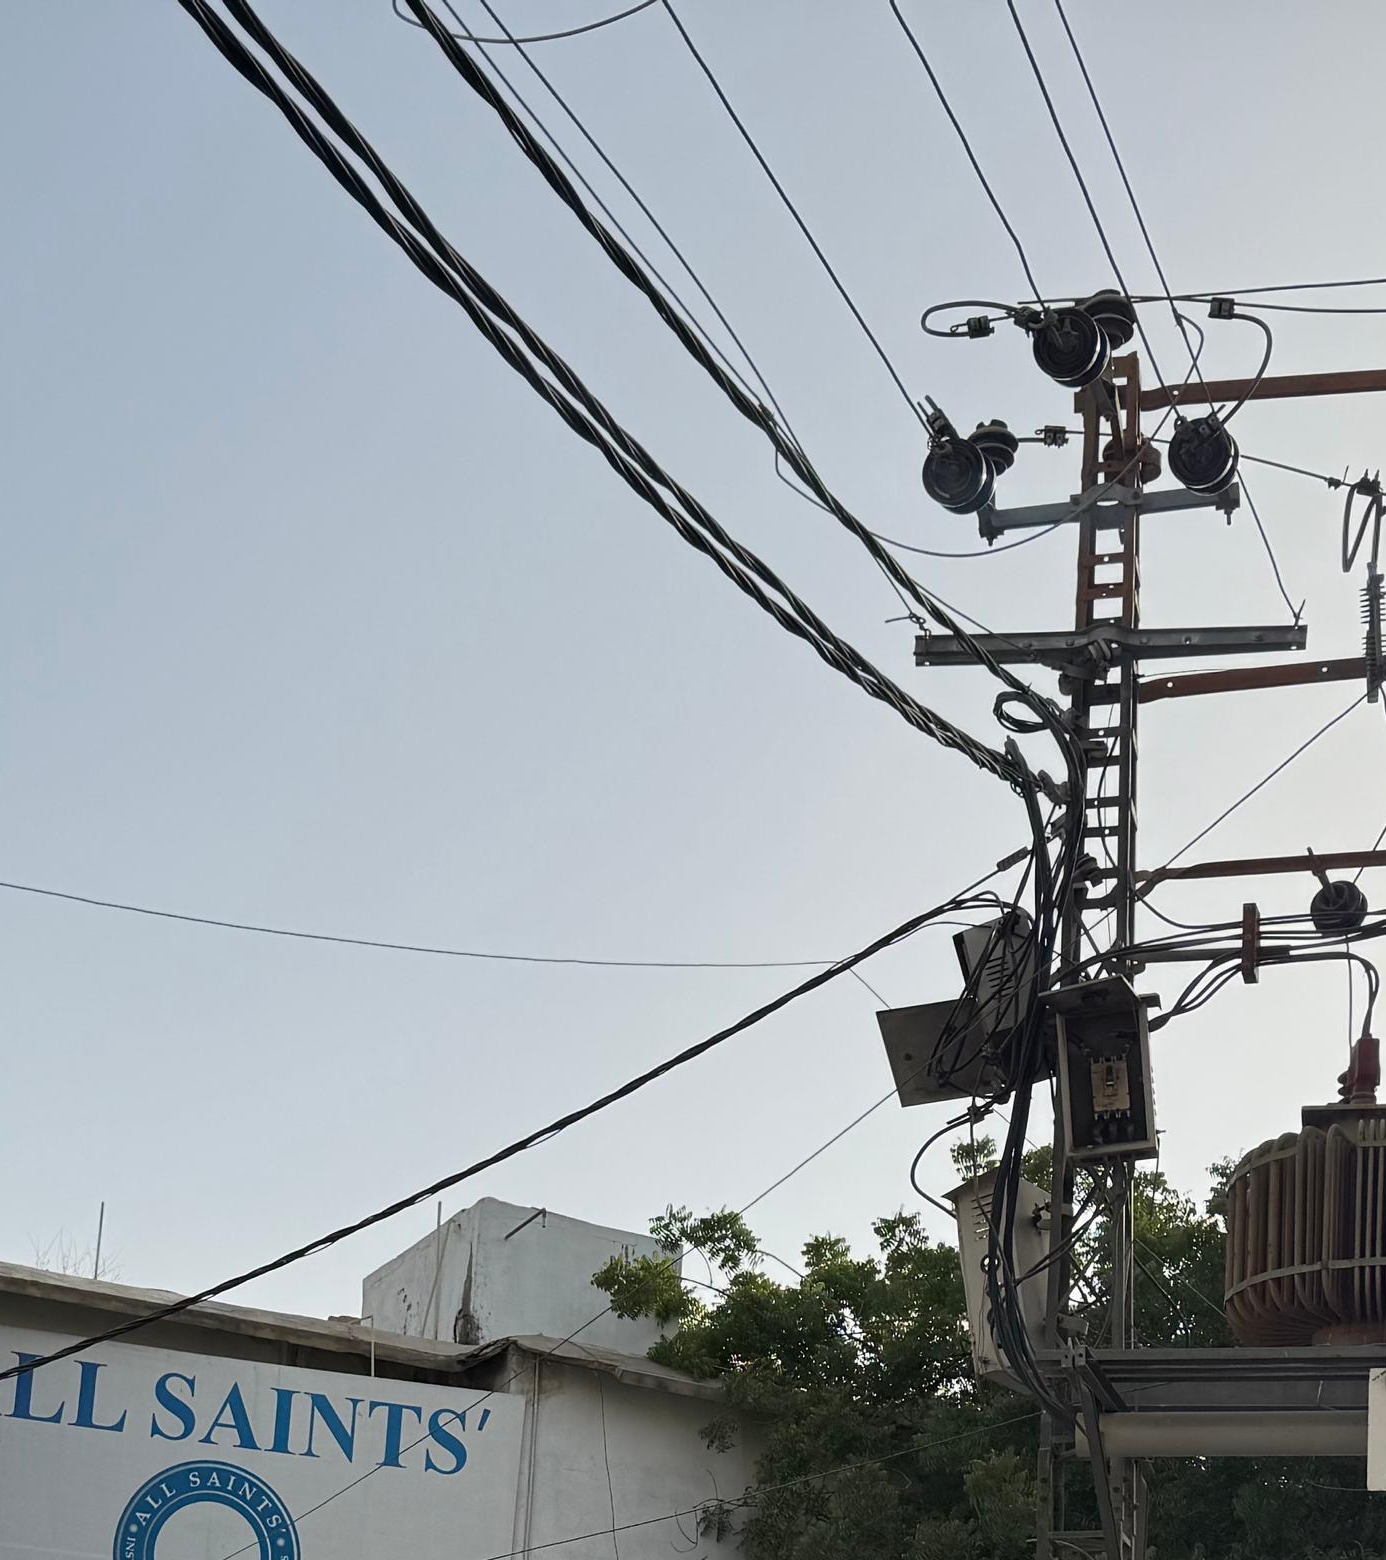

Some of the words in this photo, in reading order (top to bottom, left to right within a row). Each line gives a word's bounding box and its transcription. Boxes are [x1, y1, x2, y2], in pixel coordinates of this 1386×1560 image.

[151, 1372, 491, 1475] SAINTS'
[135, 1482, 176, 1526] ALL
[189, 1471, 288, 1533] SAINTS'
